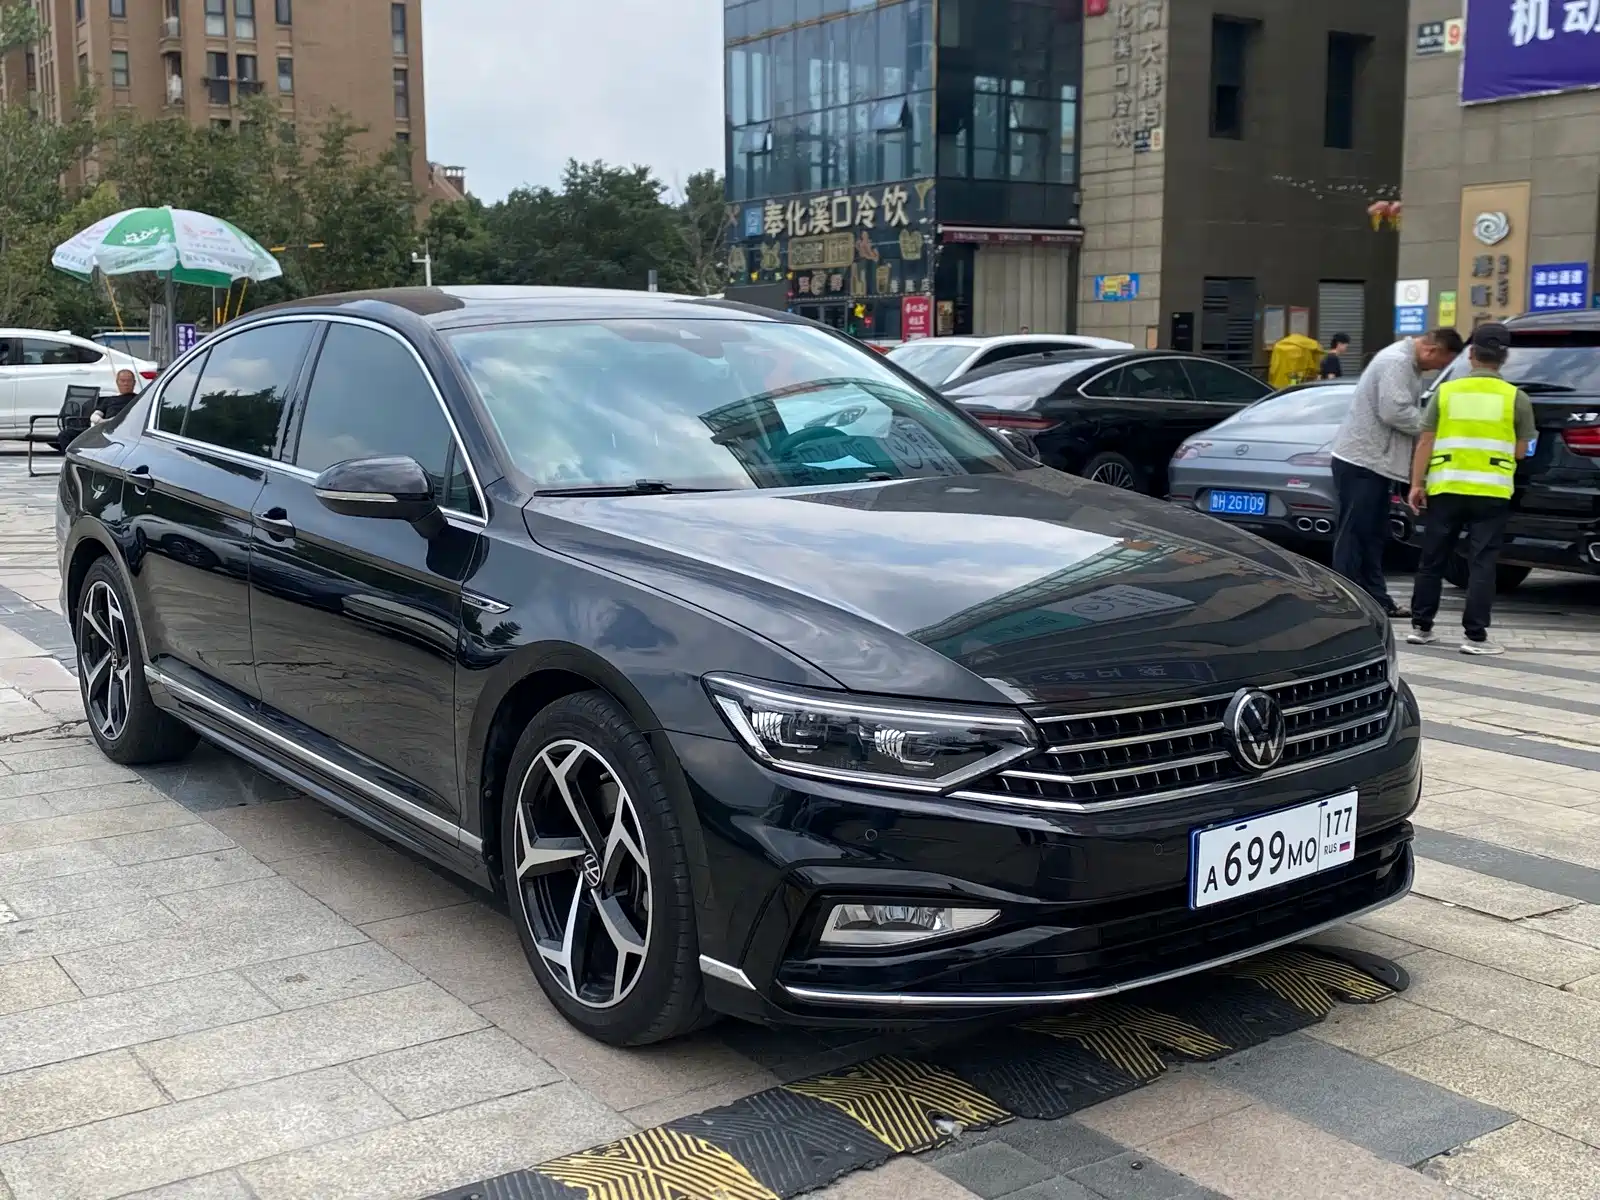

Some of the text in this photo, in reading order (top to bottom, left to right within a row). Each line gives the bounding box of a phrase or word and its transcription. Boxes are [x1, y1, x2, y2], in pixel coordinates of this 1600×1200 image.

[1448, 24, 1461, 45] 9
[764, 184, 909, 238] 奉化溪口冷饮
[1326, 806, 1353, 838] 177
[1324, 844, 1338, 855] RUS
